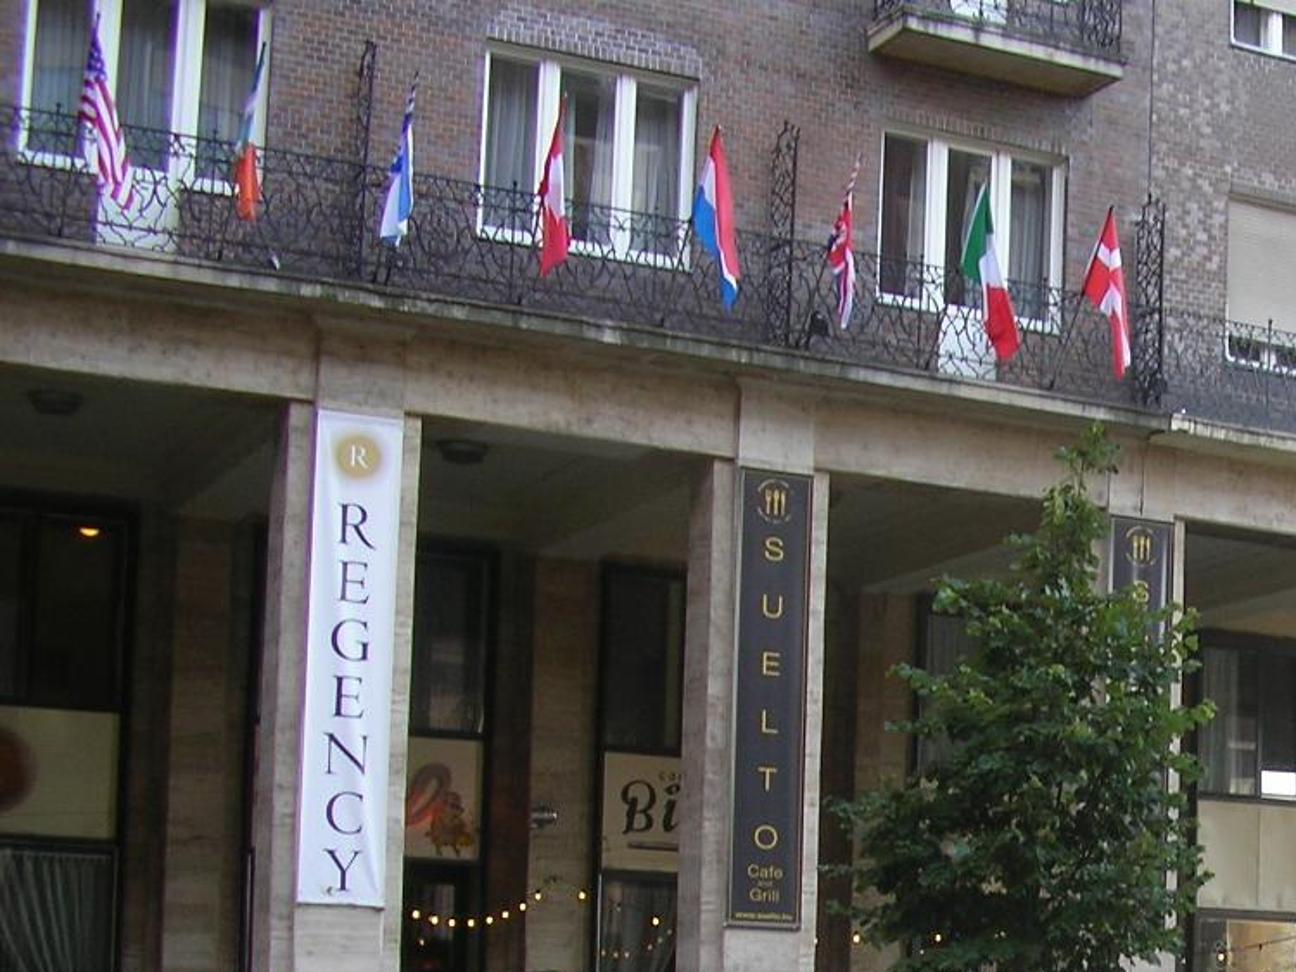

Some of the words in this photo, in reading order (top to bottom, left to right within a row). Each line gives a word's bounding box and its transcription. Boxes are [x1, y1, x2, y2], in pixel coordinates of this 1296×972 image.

[350, 444, 369, 469] R
[323, 502, 375, 892] REGENCY
[754, 537, 784, 850] SUELTO
[747, 864, 783, 880] Cafe
[749, 888, 780, 902] Grill
